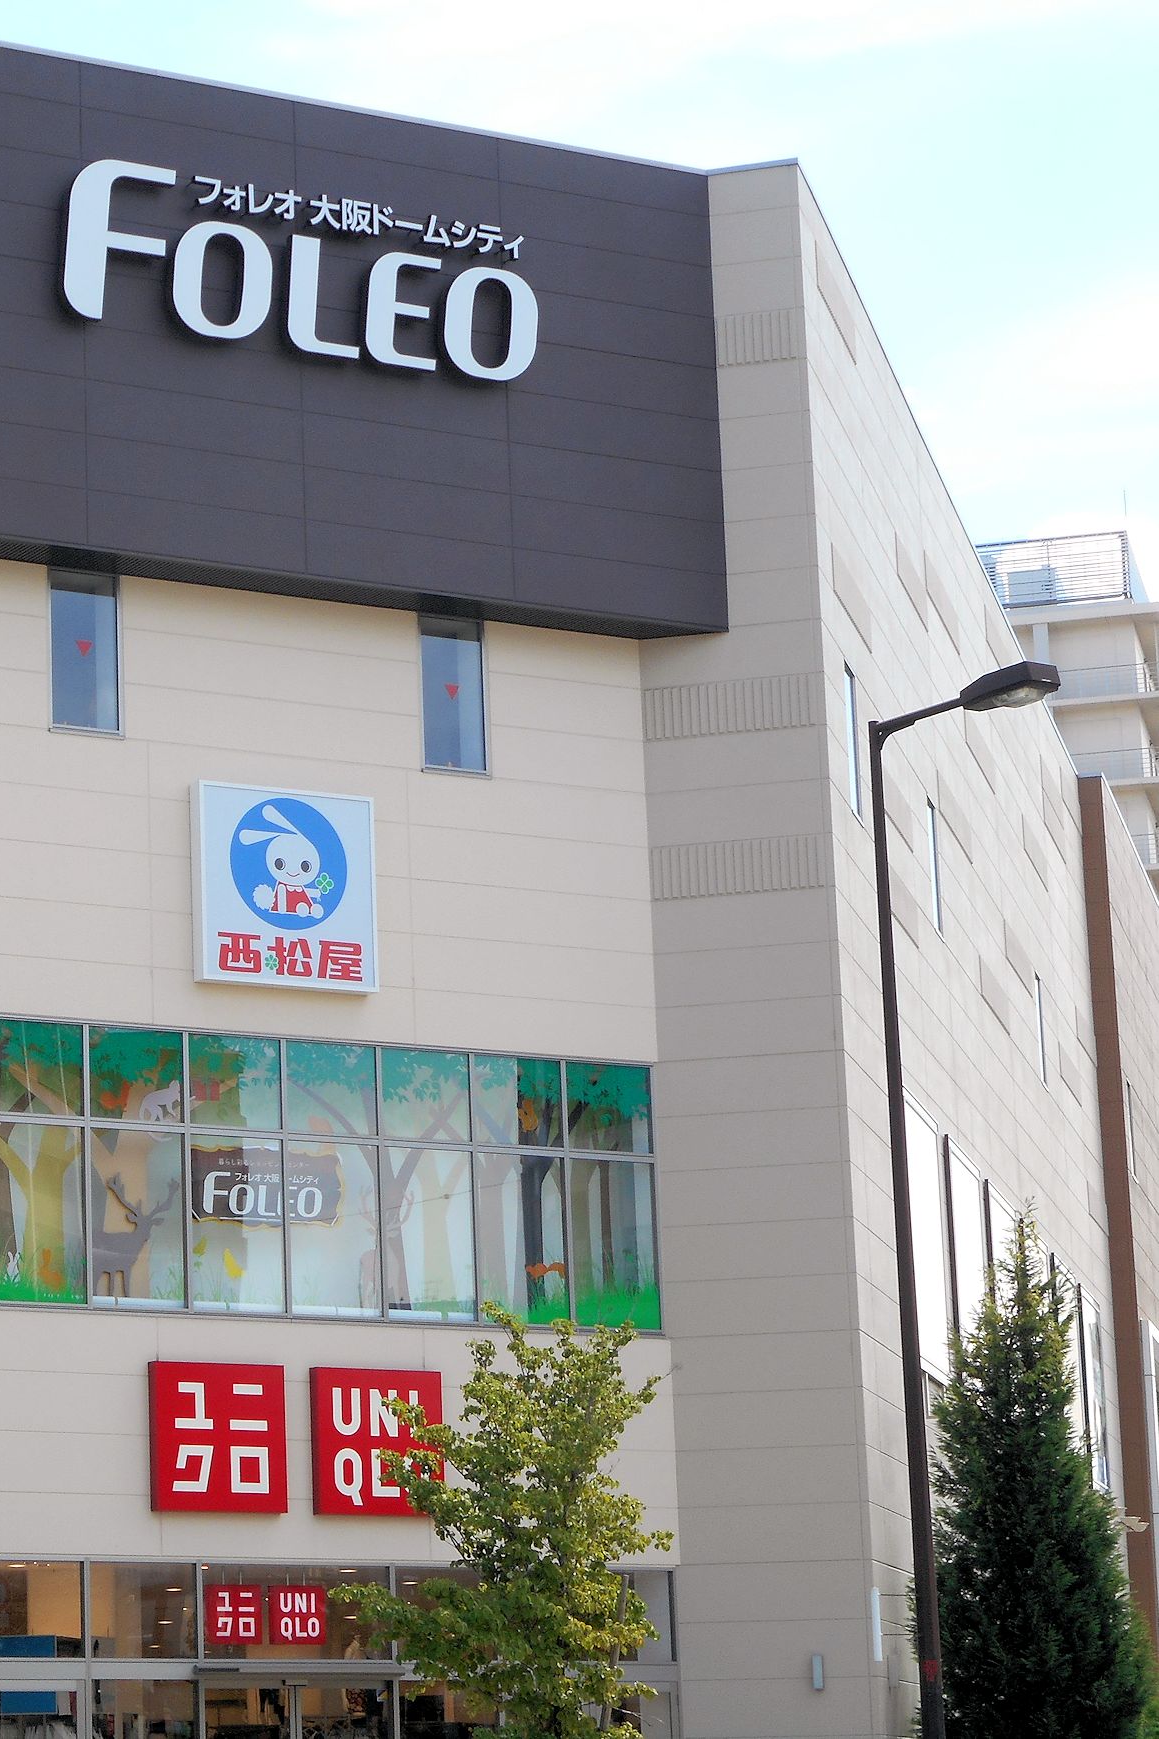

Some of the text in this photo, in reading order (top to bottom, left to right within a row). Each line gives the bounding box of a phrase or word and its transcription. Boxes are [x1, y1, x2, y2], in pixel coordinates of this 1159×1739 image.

[194, 175, 525, 260] フォレオ 大阪ドームシティ
[63, 159, 539, 382] FOLEO
[217, 931, 363, 982] 西松屋
[235, 1172, 319, 1185] フォレオ 大阪ムシティ
[174, 1381, 269, 1432] ユニ
[279, 1592, 316, 1614] UNI
[280, 1616, 321, 1641] QLO
